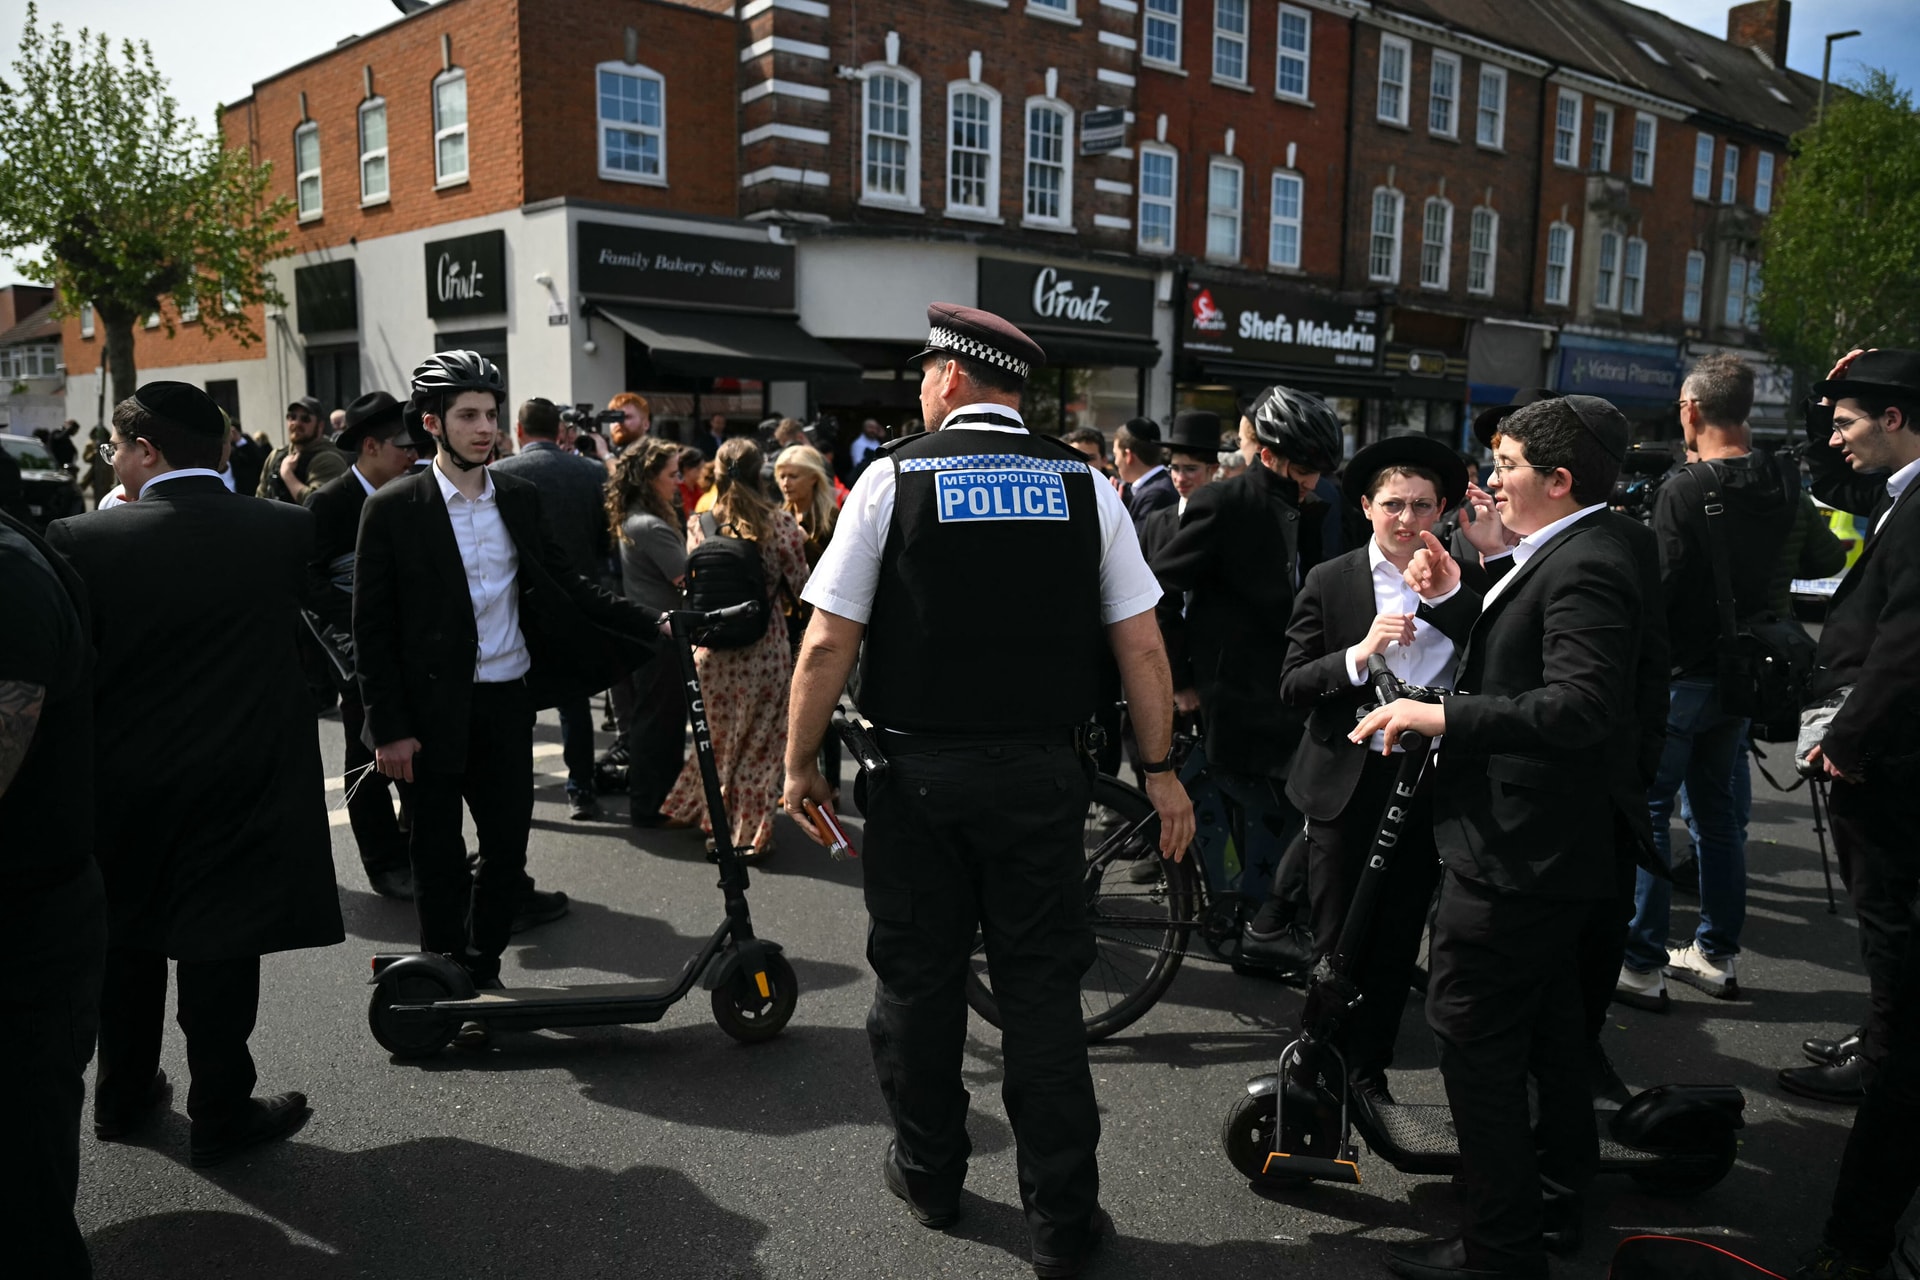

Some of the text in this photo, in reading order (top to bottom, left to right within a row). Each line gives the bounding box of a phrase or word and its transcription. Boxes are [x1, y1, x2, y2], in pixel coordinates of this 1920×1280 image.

[598, 248, 782, 282] Family Bakery Since 1888
[1032, 267, 1112, 324] Grodz
[1238, 310, 1376, 353] Shefa Mehadrin
[1588, 359, 1674, 389] Victoria Pharmacy
[942, 473, 1060, 486] METROPOLITAN
[943, 486, 1065, 517] POLICE
[687, 679, 711, 752] PURE
[1369, 780, 1417, 871] PURE
